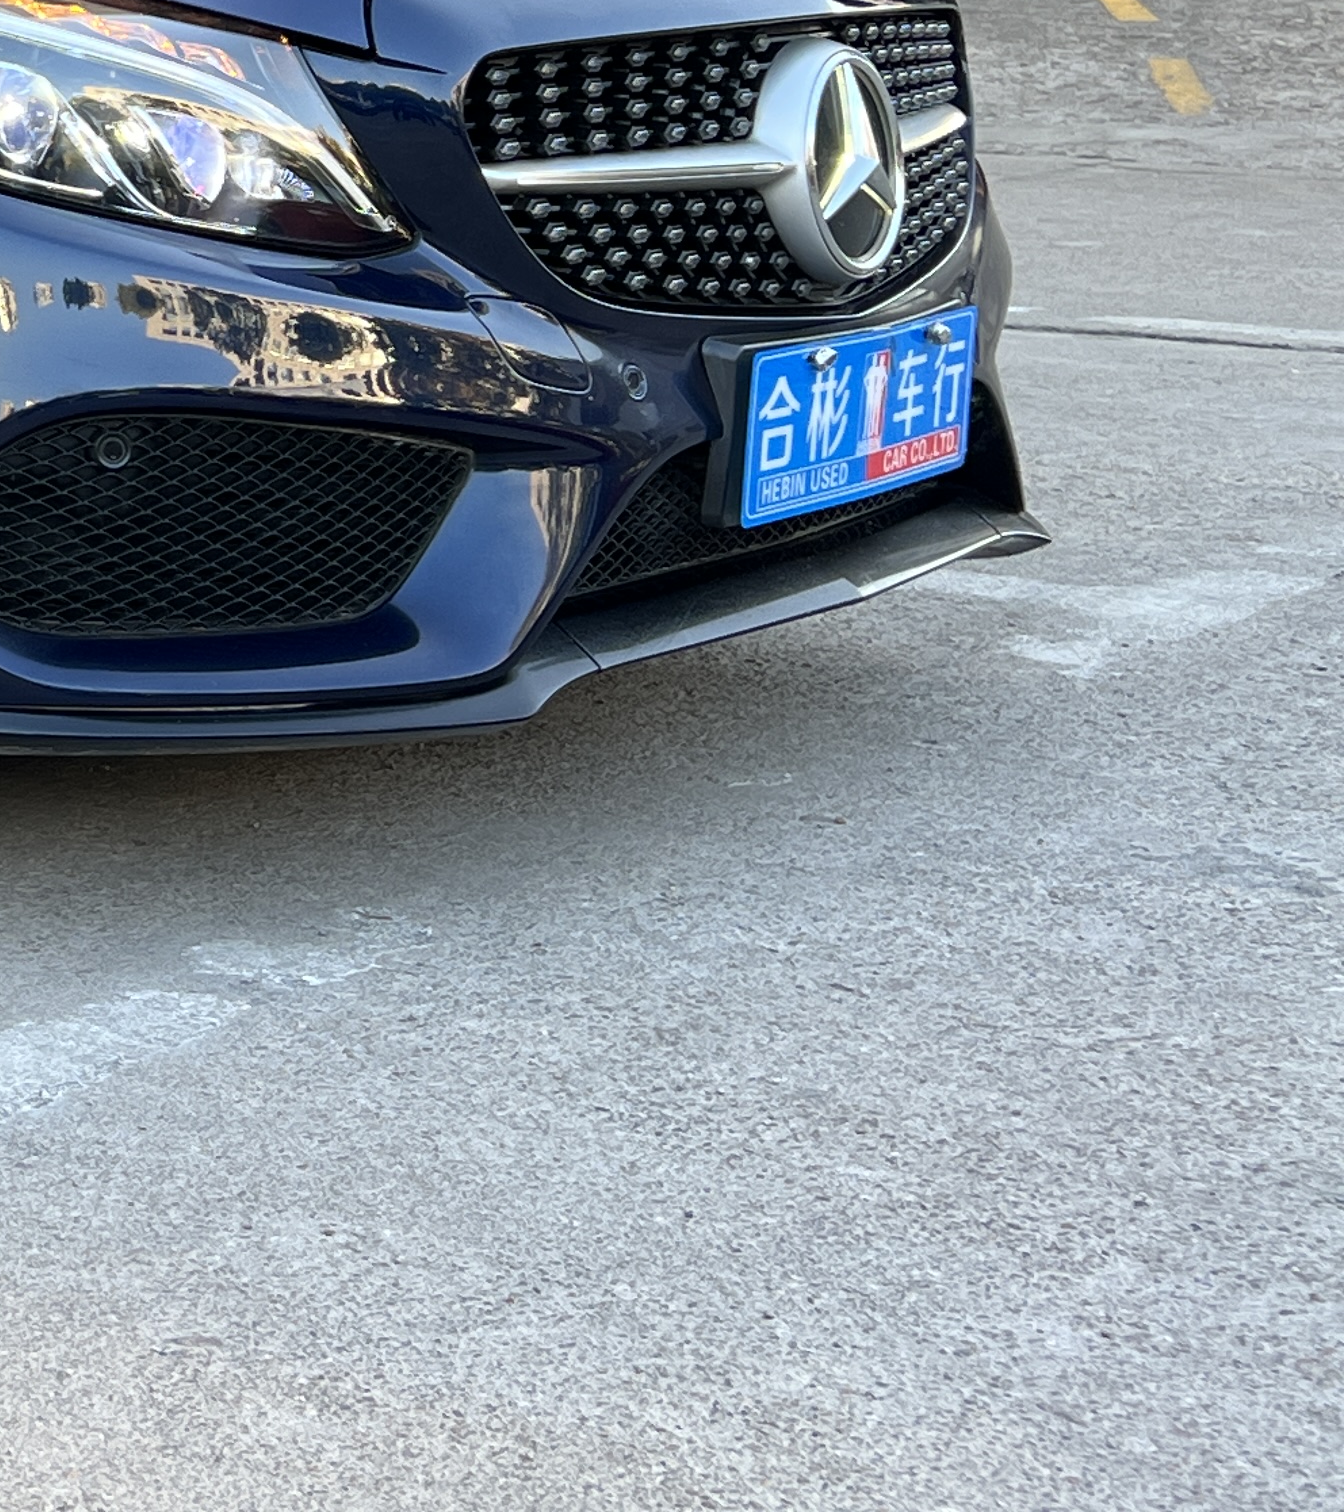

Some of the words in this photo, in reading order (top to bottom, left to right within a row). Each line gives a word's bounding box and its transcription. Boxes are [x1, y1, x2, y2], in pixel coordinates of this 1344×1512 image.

[758, 364, 852, 472] 合彬
[892, 340, 966, 437] 车行
[882, 443, 909, 473] CAR
[761, 472, 806, 506] HEBIN
[809, 460, 849, 492] USED
